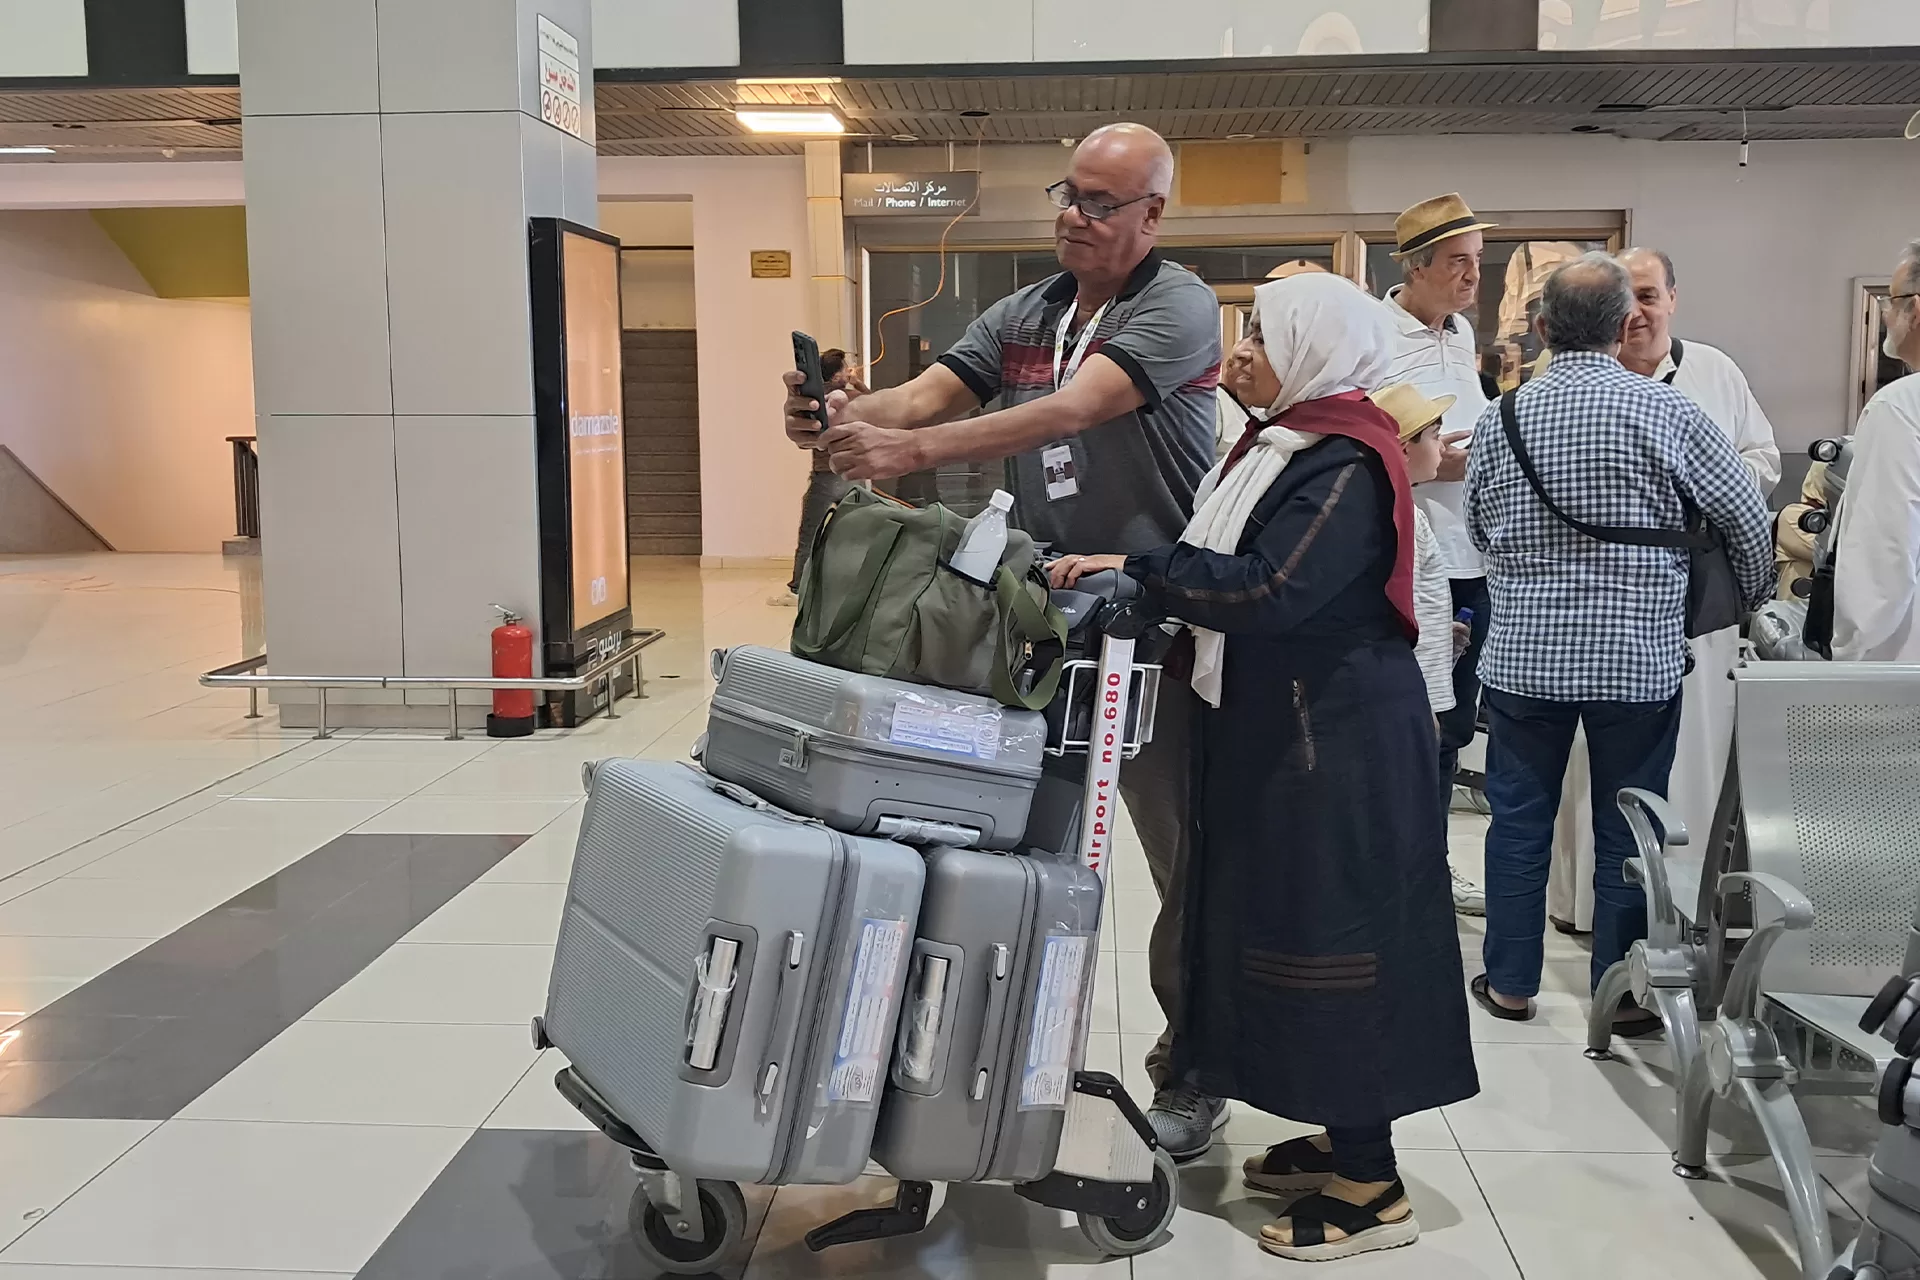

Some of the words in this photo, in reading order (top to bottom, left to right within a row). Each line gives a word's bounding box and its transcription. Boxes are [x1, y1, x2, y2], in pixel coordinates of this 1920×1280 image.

[873, 180, 919, 193] الاتصالات
[921, 180, 947, 196] مركز
[853, 198, 874, 207] Mail
[885, 197, 917, 208] Phone
[927, 197, 967, 208] Internet
[1102, 672, 1121, 763] no.680
